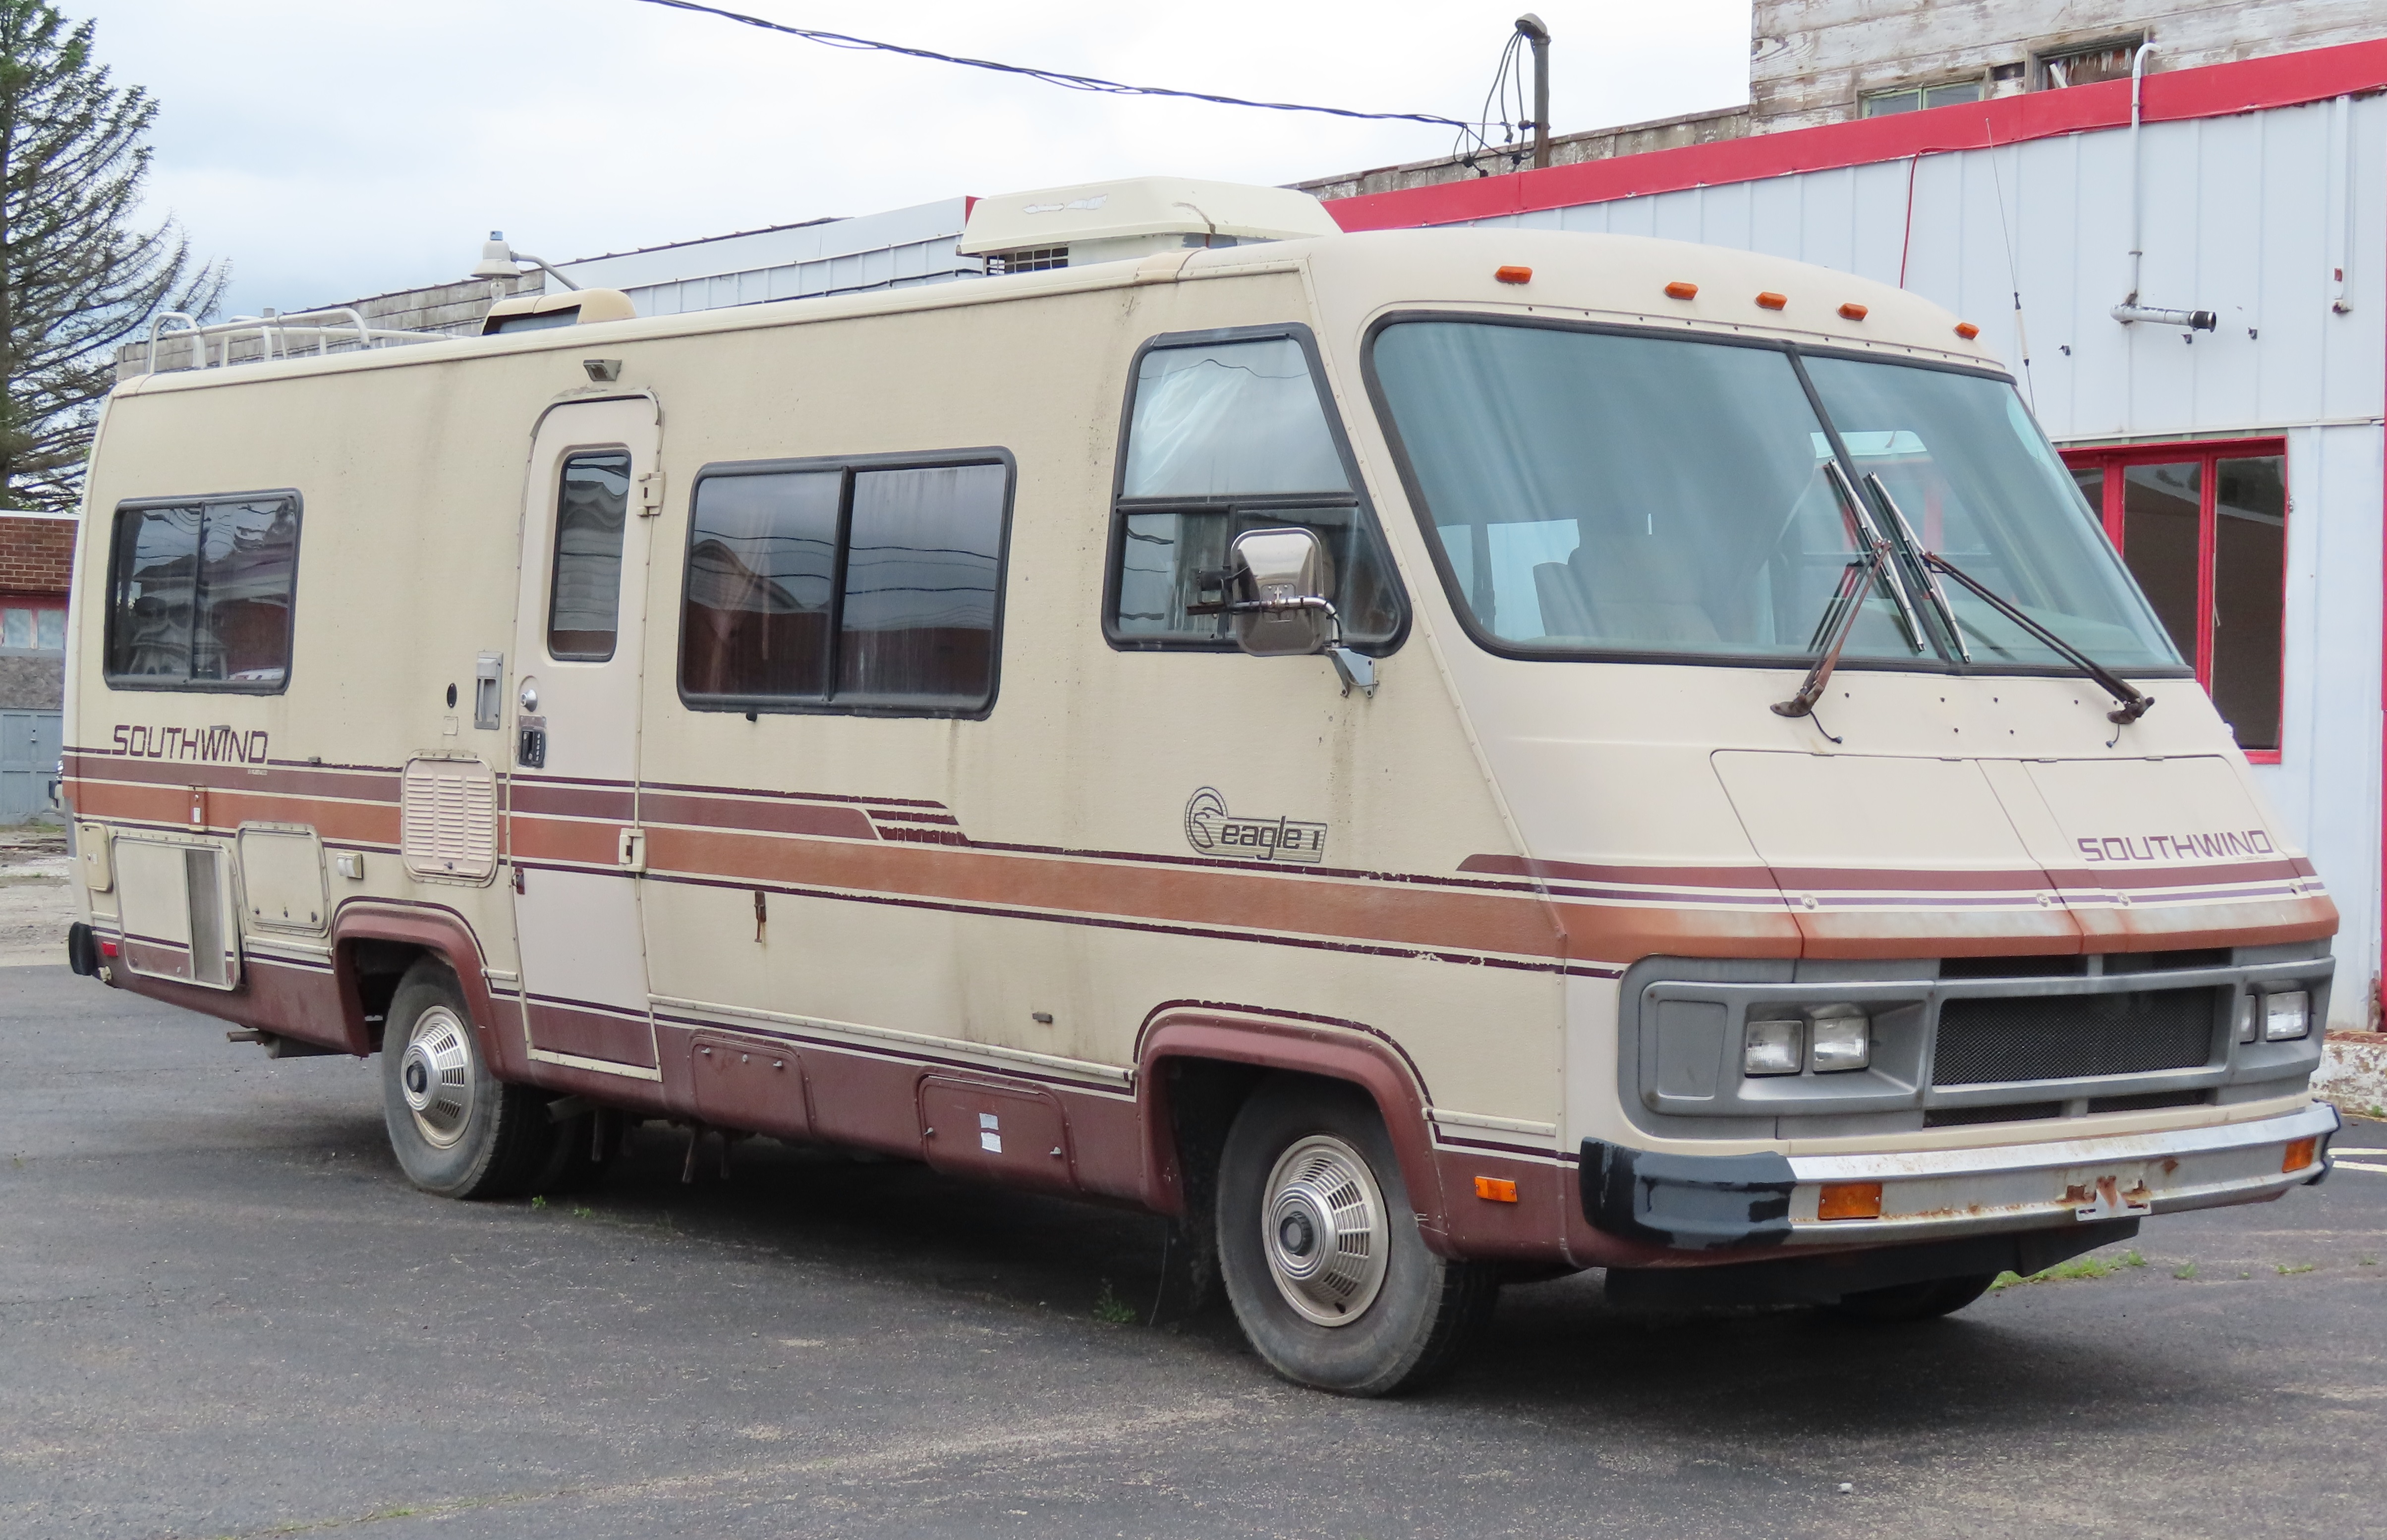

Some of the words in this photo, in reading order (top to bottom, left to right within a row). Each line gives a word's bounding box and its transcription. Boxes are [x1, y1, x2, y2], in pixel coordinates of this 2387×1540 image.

[112, 725, 269, 764] SOUTHWIND
[1221, 815, 1302, 861] eagle
[2077, 829, 2274, 862] SOUTHWIND
